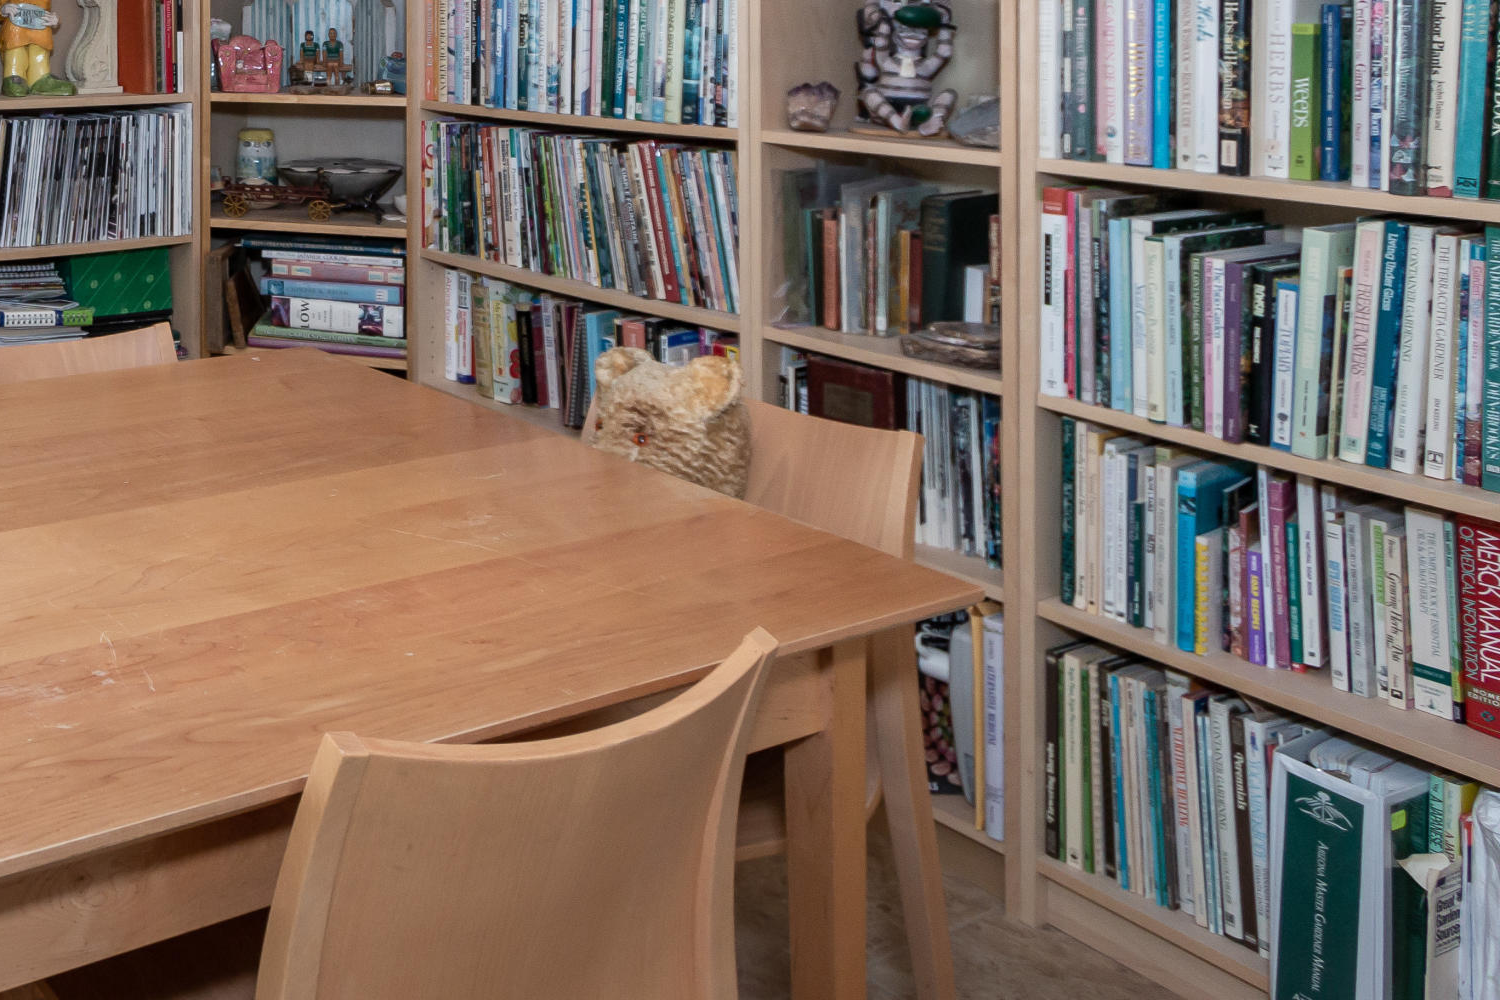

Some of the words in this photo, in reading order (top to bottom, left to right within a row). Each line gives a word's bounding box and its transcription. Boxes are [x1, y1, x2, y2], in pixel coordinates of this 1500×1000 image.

[518, 13, 527, 46] Home
[1223, 1, 1238, 31] Herbs
[1431, 1, 1446, 37] Indoor
[1223, 34, 1237, 53] and
[1429, 40, 1444, 75] Plants
[1221, 55, 1237, 109] Herbalism
[1354, 63, 1366, 100] Garden
[1386, 232, 1399, 259] Living
[1439, 245, 1450, 263] THE
[1383, 260, 1396, 287] Under
[1435, 266, 1449, 325] TERRACOTTA
[1432, 328, 1445, 378] GARDENER
[1459, 525, 1474, 542] OF
[1460, 545, 1474, 594] MEDICAL
[1474, 530, 1500, 597] MERCK
[1460, 597, 1476, 680] INFORMATION
[1475, 599, 1500, 682] MANUAL
[1233, 752, 1247, 809] Perennials
[1313, 878, 1327, 911] MASTER
[1311, 913, 1325, 954] GARDENER
[1310, 955, 1323, 991] MANUAL
